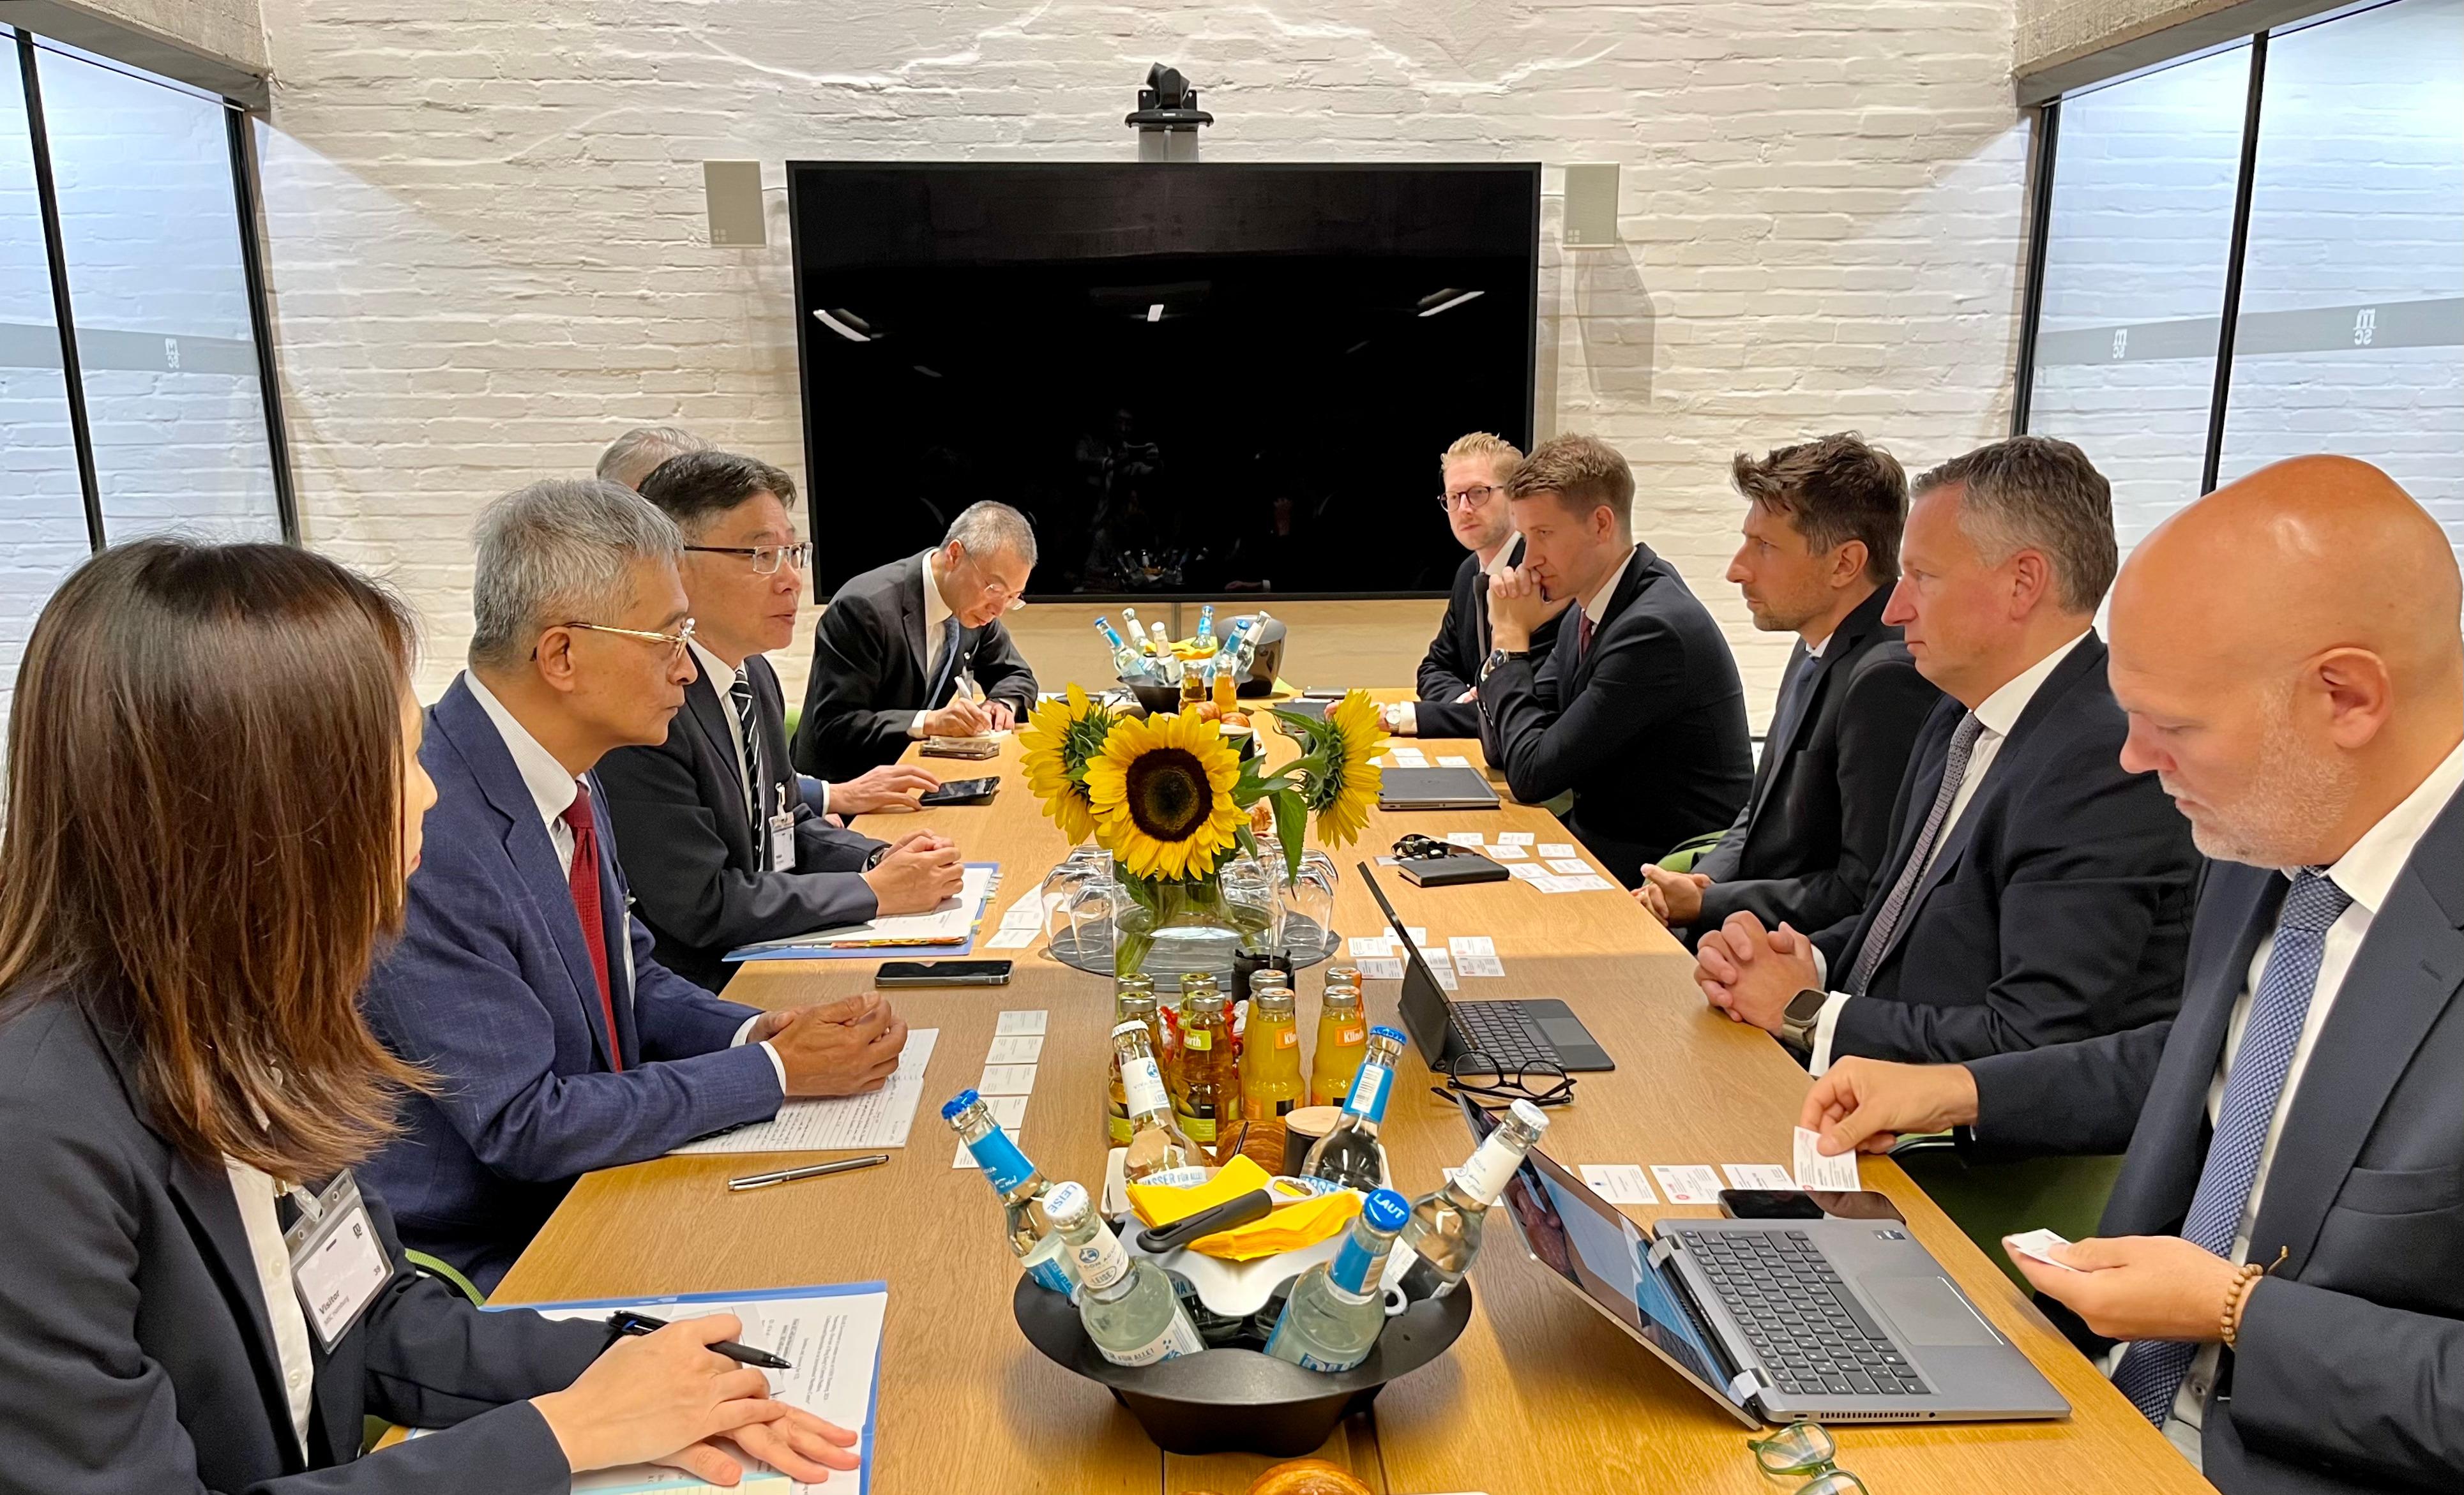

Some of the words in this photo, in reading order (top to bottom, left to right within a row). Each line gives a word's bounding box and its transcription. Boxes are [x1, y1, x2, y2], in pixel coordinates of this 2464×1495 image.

[1047, 1184, 1078, 1213] LEISE
[1373, 1193, 1405, 1220] LAUT
[319, 1289, 340, 1315] Visitor
[1133, 1348, 1154, 1360] ALLE!
